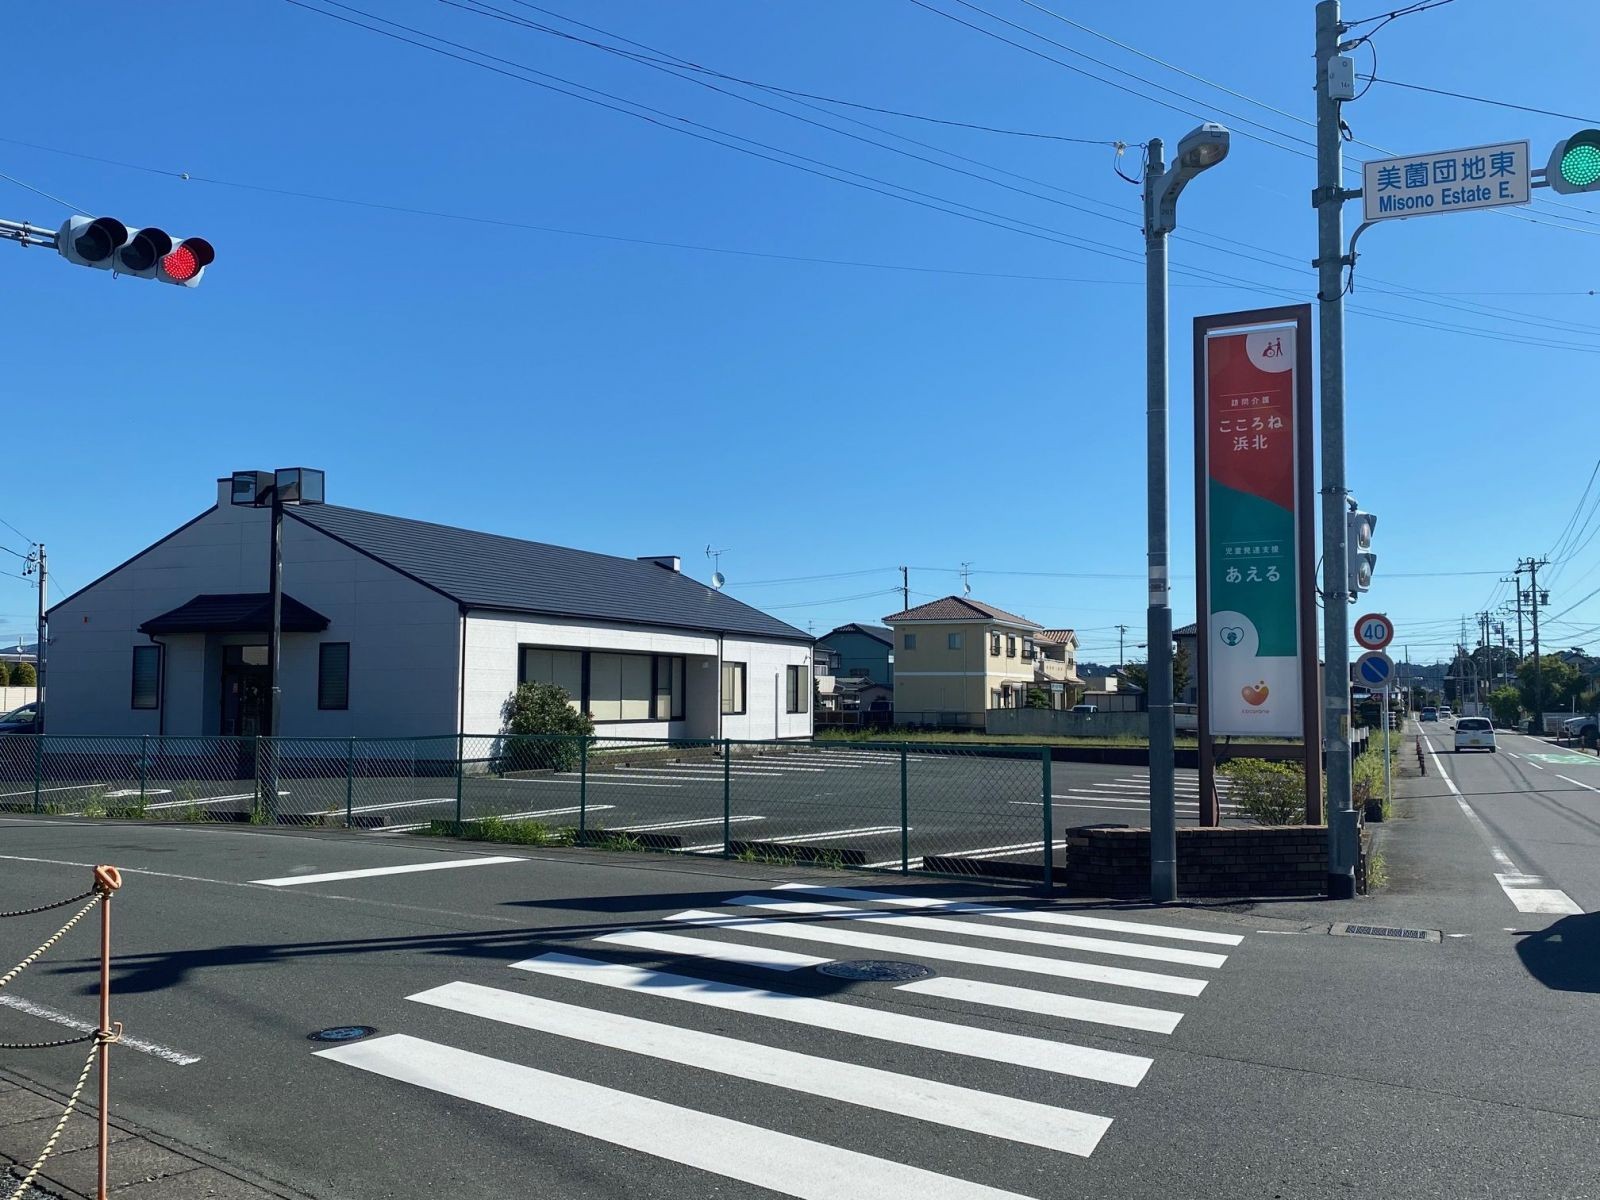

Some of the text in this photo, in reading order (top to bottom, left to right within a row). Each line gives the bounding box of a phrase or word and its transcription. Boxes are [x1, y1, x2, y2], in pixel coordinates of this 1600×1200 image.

[1377, 151, 1516, 192] 美薗団地東
[1379, 181, 1514, 213] Misono Estate E.
[1219, 415, 1283, 433] こころね
[1233, 434, 1268, 451] 浜北
[1225, 565, 1280, 583] あえる
[1364, 624, 1385, 640] 40
